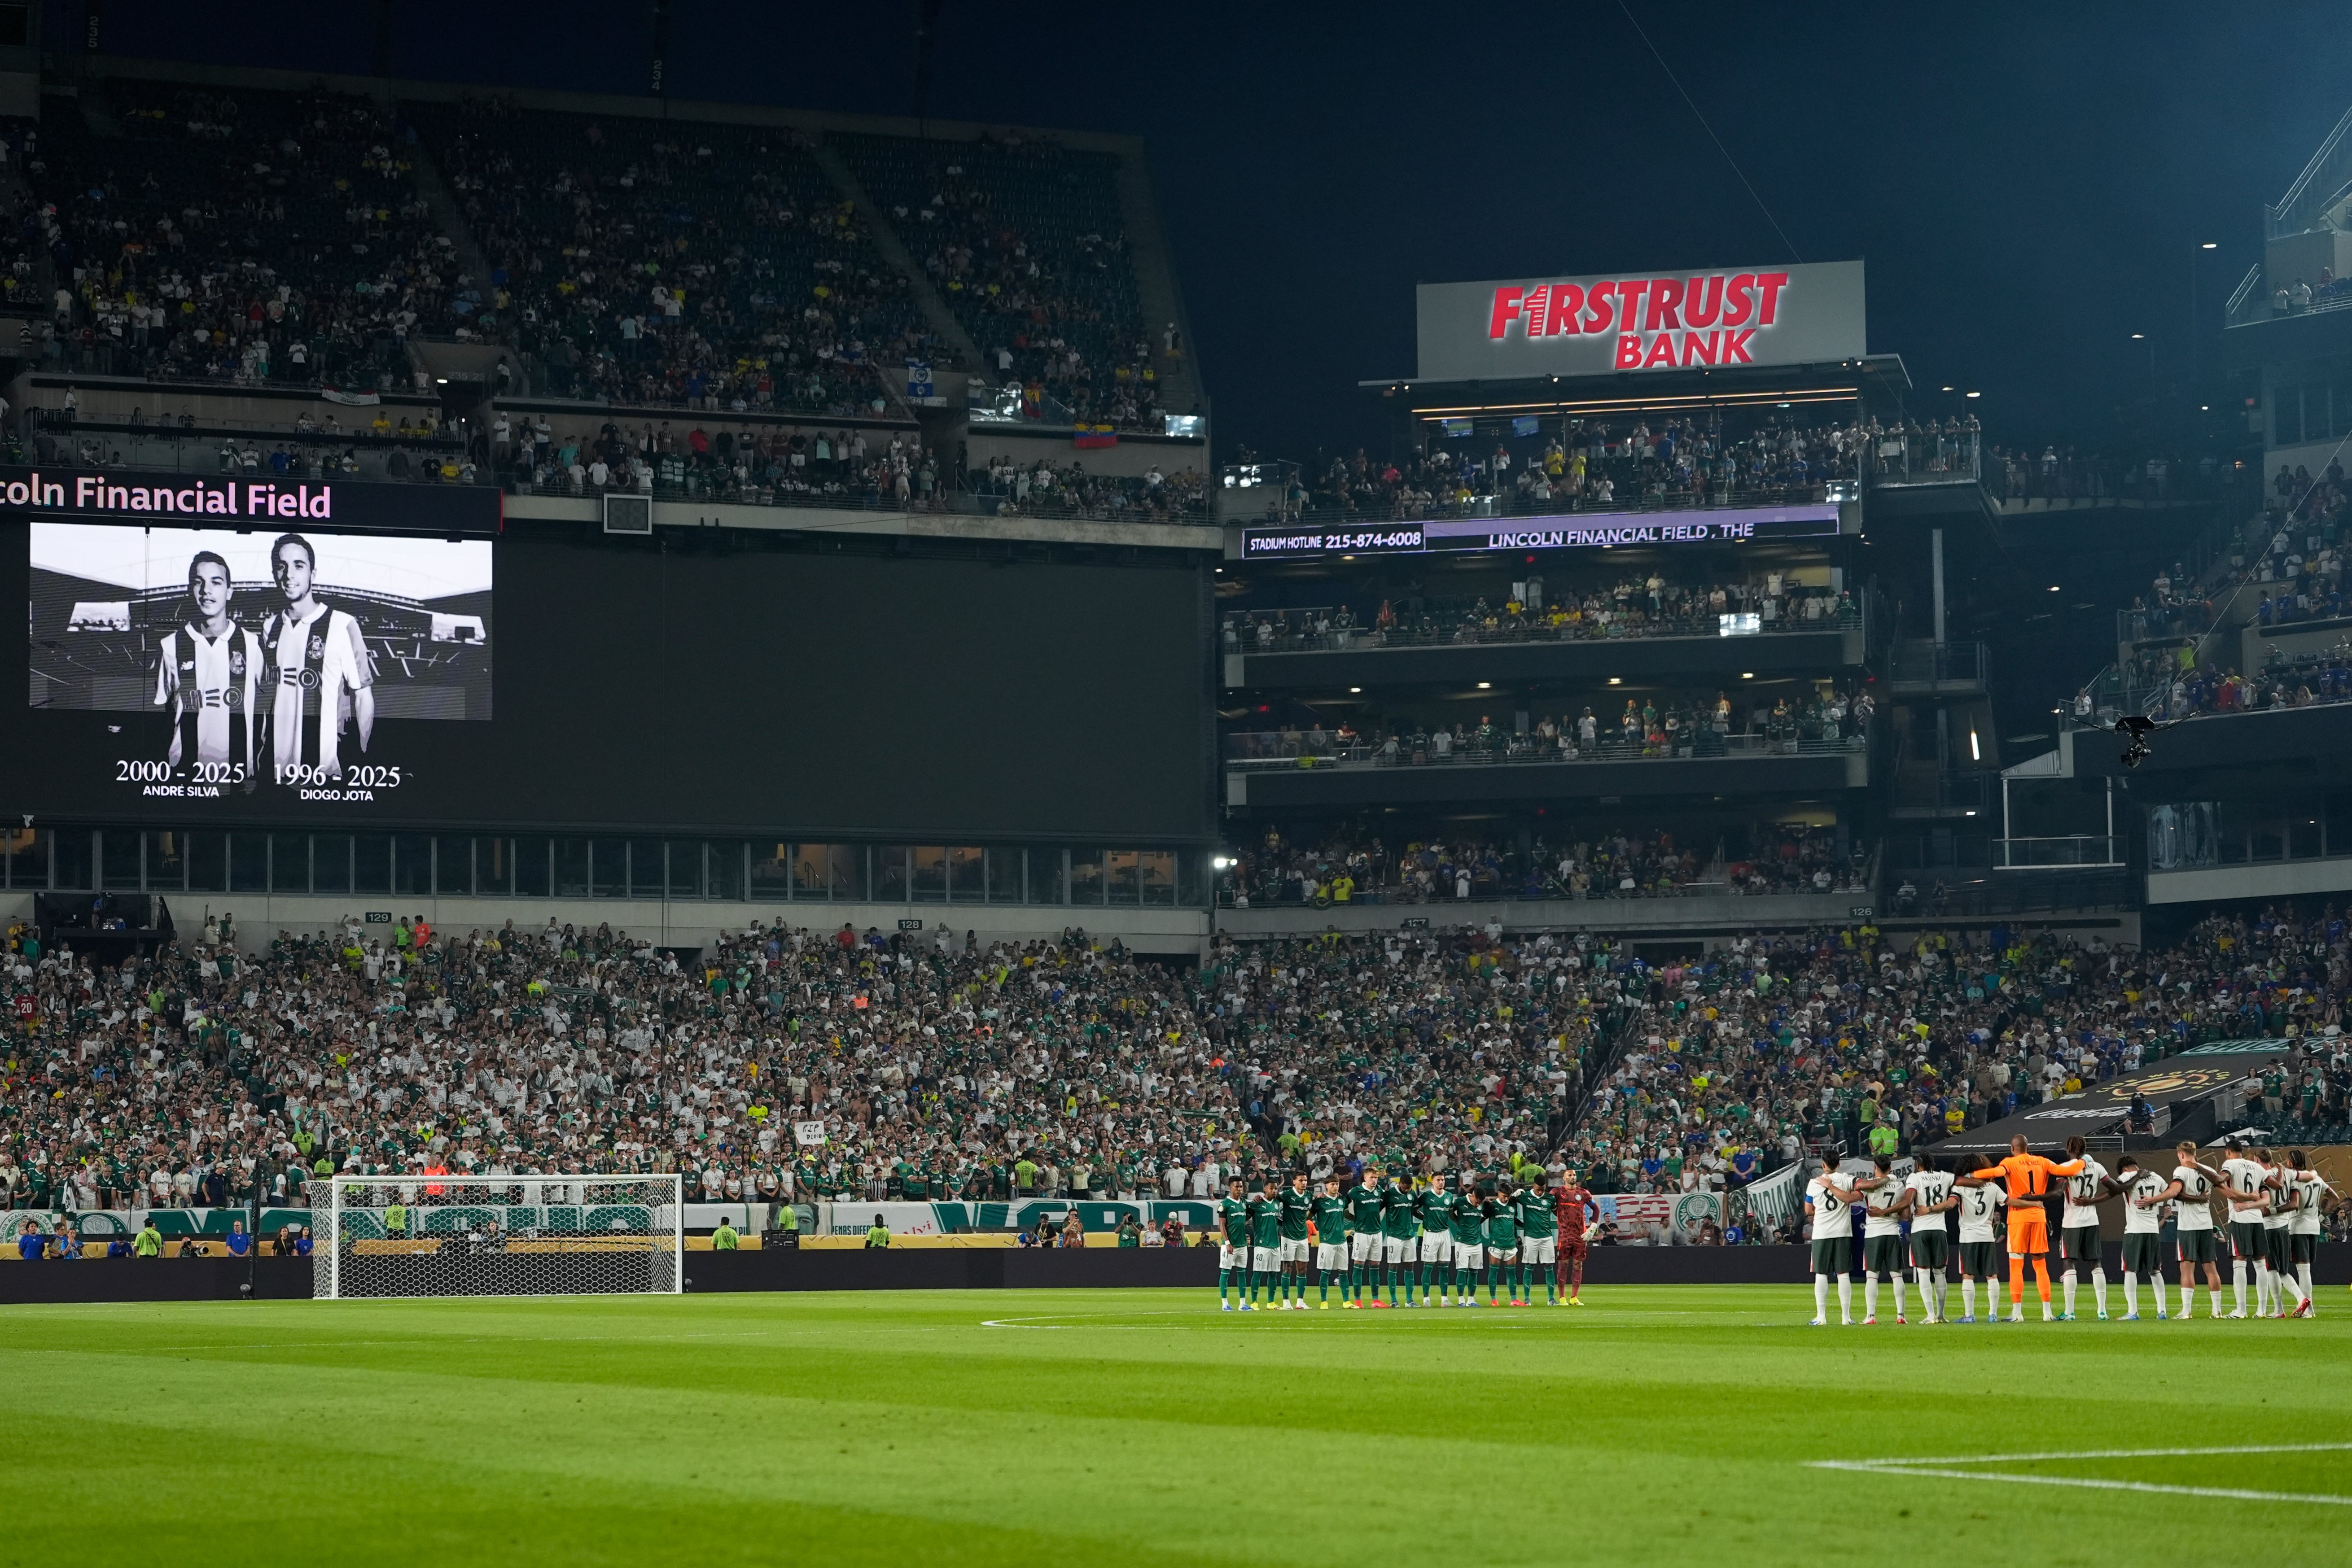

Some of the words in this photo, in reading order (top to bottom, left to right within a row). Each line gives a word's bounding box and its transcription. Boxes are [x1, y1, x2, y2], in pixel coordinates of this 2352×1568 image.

[1615, 328, 1756, 370] BANK
[77, 476, 237, 514] Financial
[249, 484, 330, 518] Field
[1250, 537, 1286, 550] STADIUM
[1287, 536, 1322, 549] HOTLINE
[1325, 532, 1421, 549] 215-874-6008
[1489, 531, 1563, 548] LINCOLN
[1567, 527, 1655, 545] FINANCIAL
[1662, 525, 1708, 541] FIELD
[1720, 523, 1754, 537] THE
[116, 760, 171, 782] 2000
[192, 761, 245, 783] 2025
[275, 764, 326, 786] 1996
[348, 765, 400, 787] 2025
[187, 786, 219, 797] SILVA
[301, 789, 341, 800] DIOGO
[342, 790, 374, 801] JOTA
[368, 913, 389, 922] 129
[1852, 908, 1872, 916] 126
[901, 921, 919, 929] 128
[21, 1003, 32, 1013] 20
[802, 1124, 819, 1133] RIP
[2028, 1170, 2036, 1194] 1
[2196, 1177, 2206, 1194] 9
[2244, 1173, 2253, 1193] 6
[1824, 1188, 1838, 1211] 8
[1883, 1192, 1895, 1216] 7
[1924, 1184, 1943, 1206] 18
[1975, 1191, 1986, 1215] 3
[2137, 1185, 2155, 1210] 17
[2304, 1183, 2321, 1208] 27
[1255, 1253, 1262, 1261] 40
[1423, 1244, 1429, 1252] 32
[1456, 1251, 1459, 1259] 9
